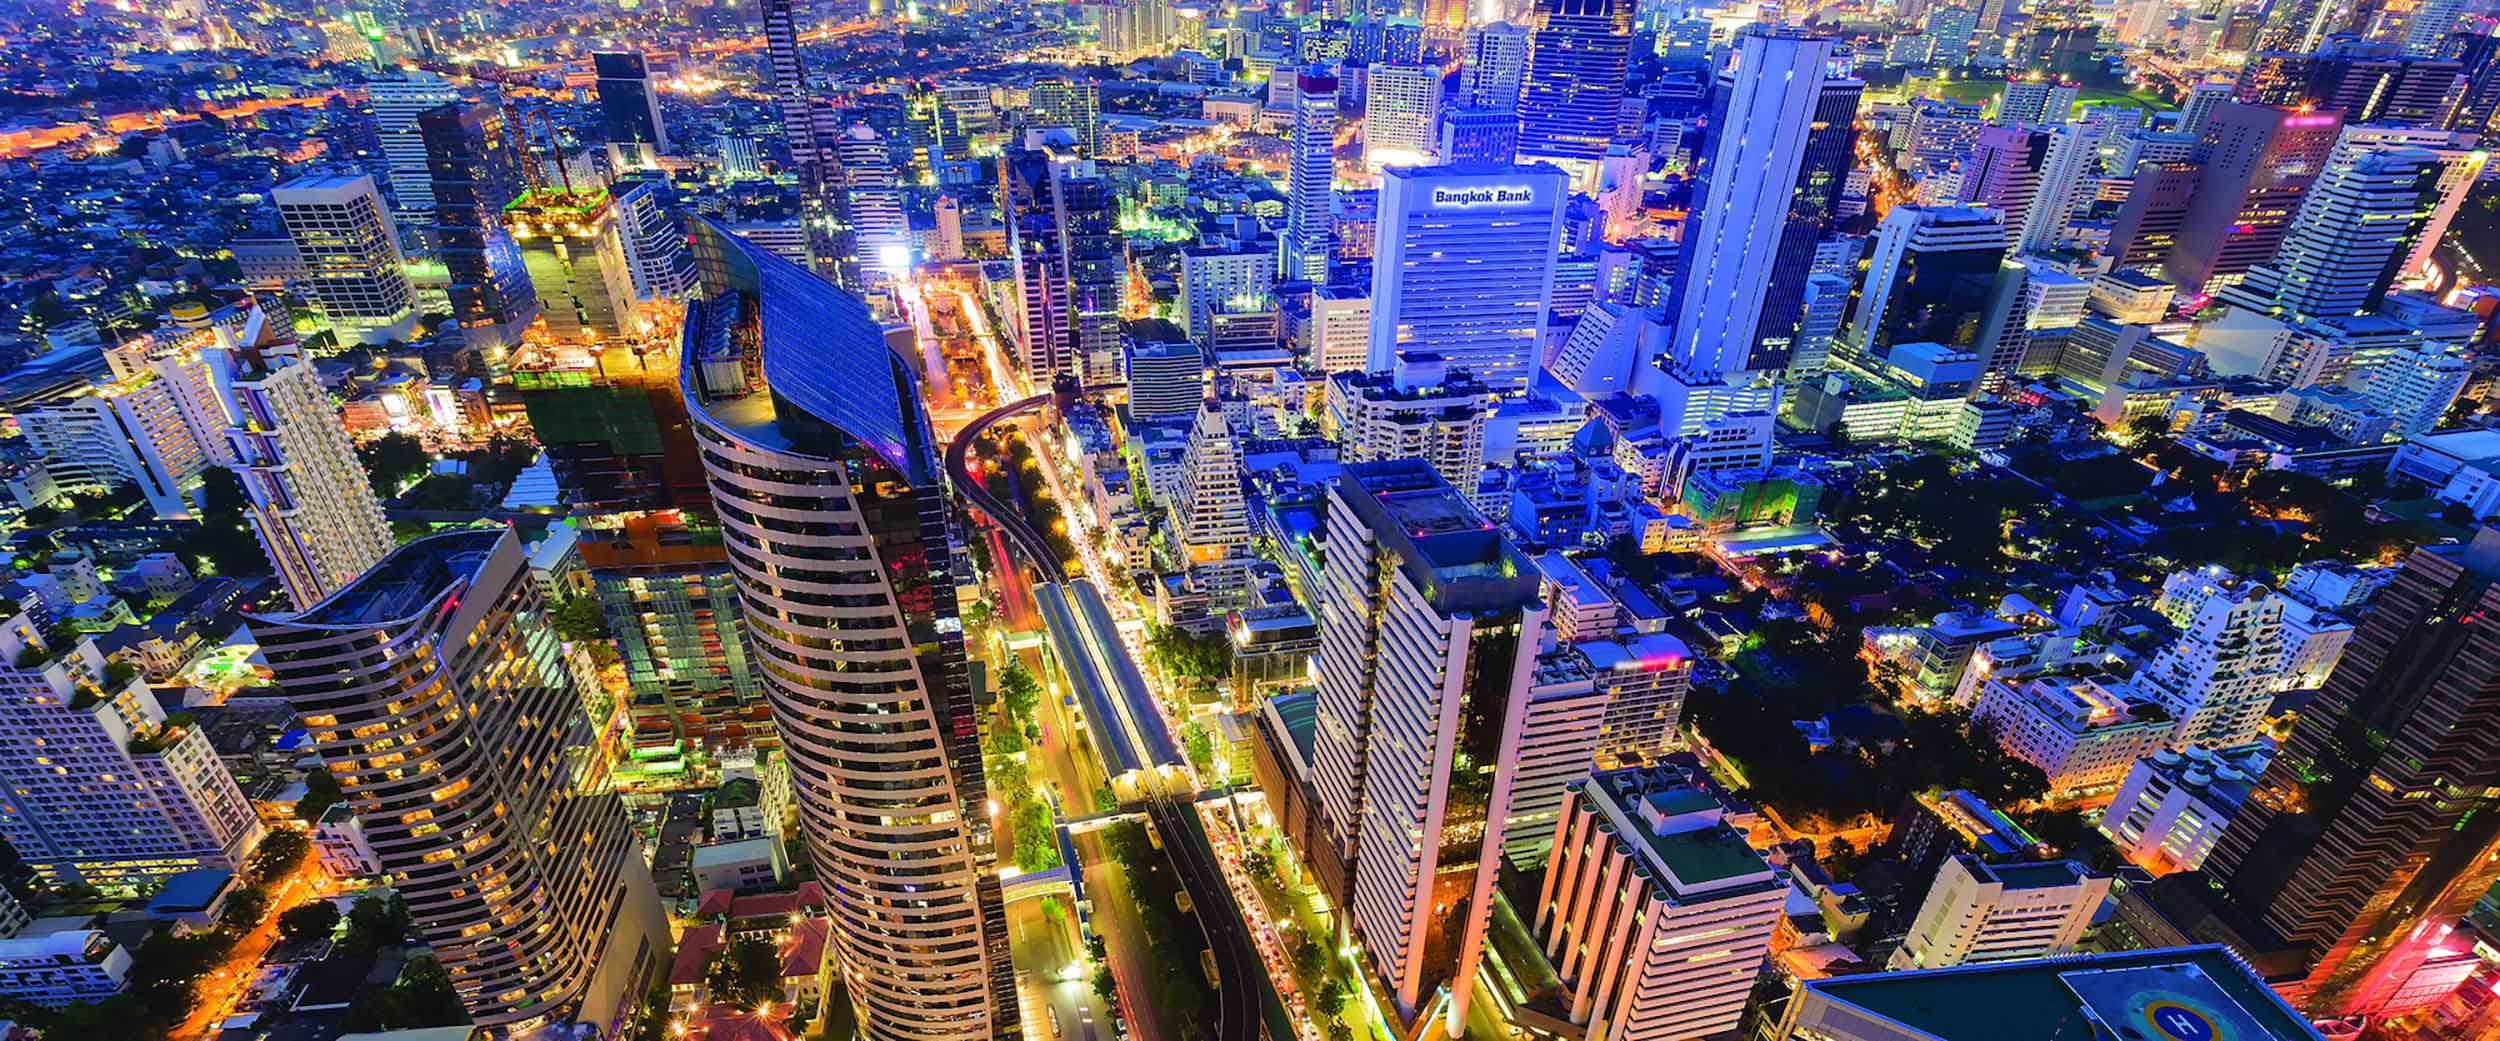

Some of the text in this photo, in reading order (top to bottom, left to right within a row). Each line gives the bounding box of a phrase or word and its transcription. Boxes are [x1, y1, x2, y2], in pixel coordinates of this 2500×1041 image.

[1435, 189, 1532, 205] Bangkok Bank
[2167, 1013, 2199, 1035] H
